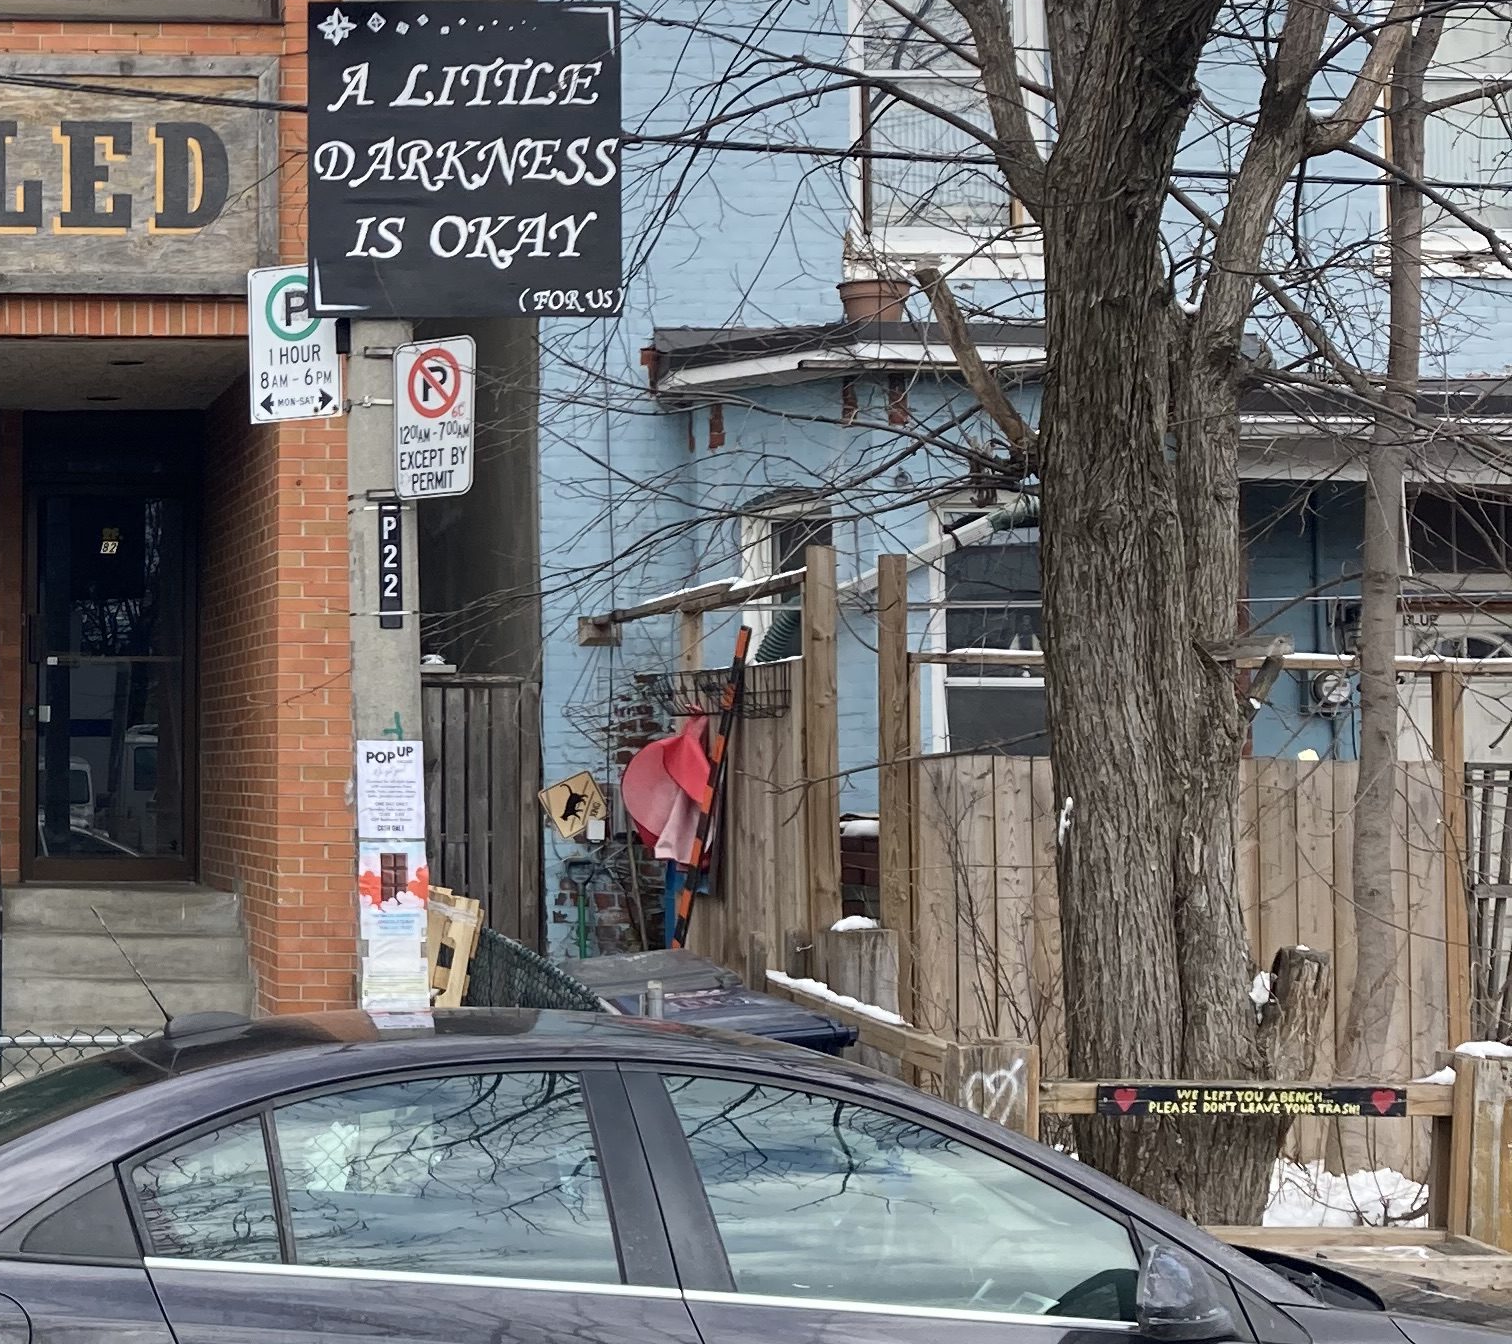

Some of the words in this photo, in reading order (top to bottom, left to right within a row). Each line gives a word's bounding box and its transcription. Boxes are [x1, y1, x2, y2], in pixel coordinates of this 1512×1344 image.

[327, 61, 374, 112] A
[389, 57, 603, 107] LITTLE
[314, 136, 620, 191] DARKNESS
[346, 215, 405, 259] IS
[429, 211, 597, 269] OKAY
[518, 287, 585, 313] (FOR
[586, 287, 624, 314] US)
[269, 348, 274, 367] 1
[279, 344, 321, 365] HOUR
[277, 396, 315, 407] MON-SAT
[400, 447, 445, 471] EXCEPT
[451, 445, 468, 465] BY
[411, 470, 455, 492] PERMIT
[366, 751, 396, 764] POP
[396, 746, 414, 757] UP
[1176, 1089, 1199, 1100] WE
[1203, 1090, 1233, 1101] LEFT
[1235, 1091, 1264, 1102] YOU
[1268, 1091, 1279, 1102] A
[1148, 1101, 1198, 1114] PLEASE
[1202, 1102, 1237, 1113] DON'T
[1240, 1102, 1281, 1114] LEAVE
[1284, 1103, 1316, 1114] YOUR
[1317, 1103, 1361, 1116] TRASH!
